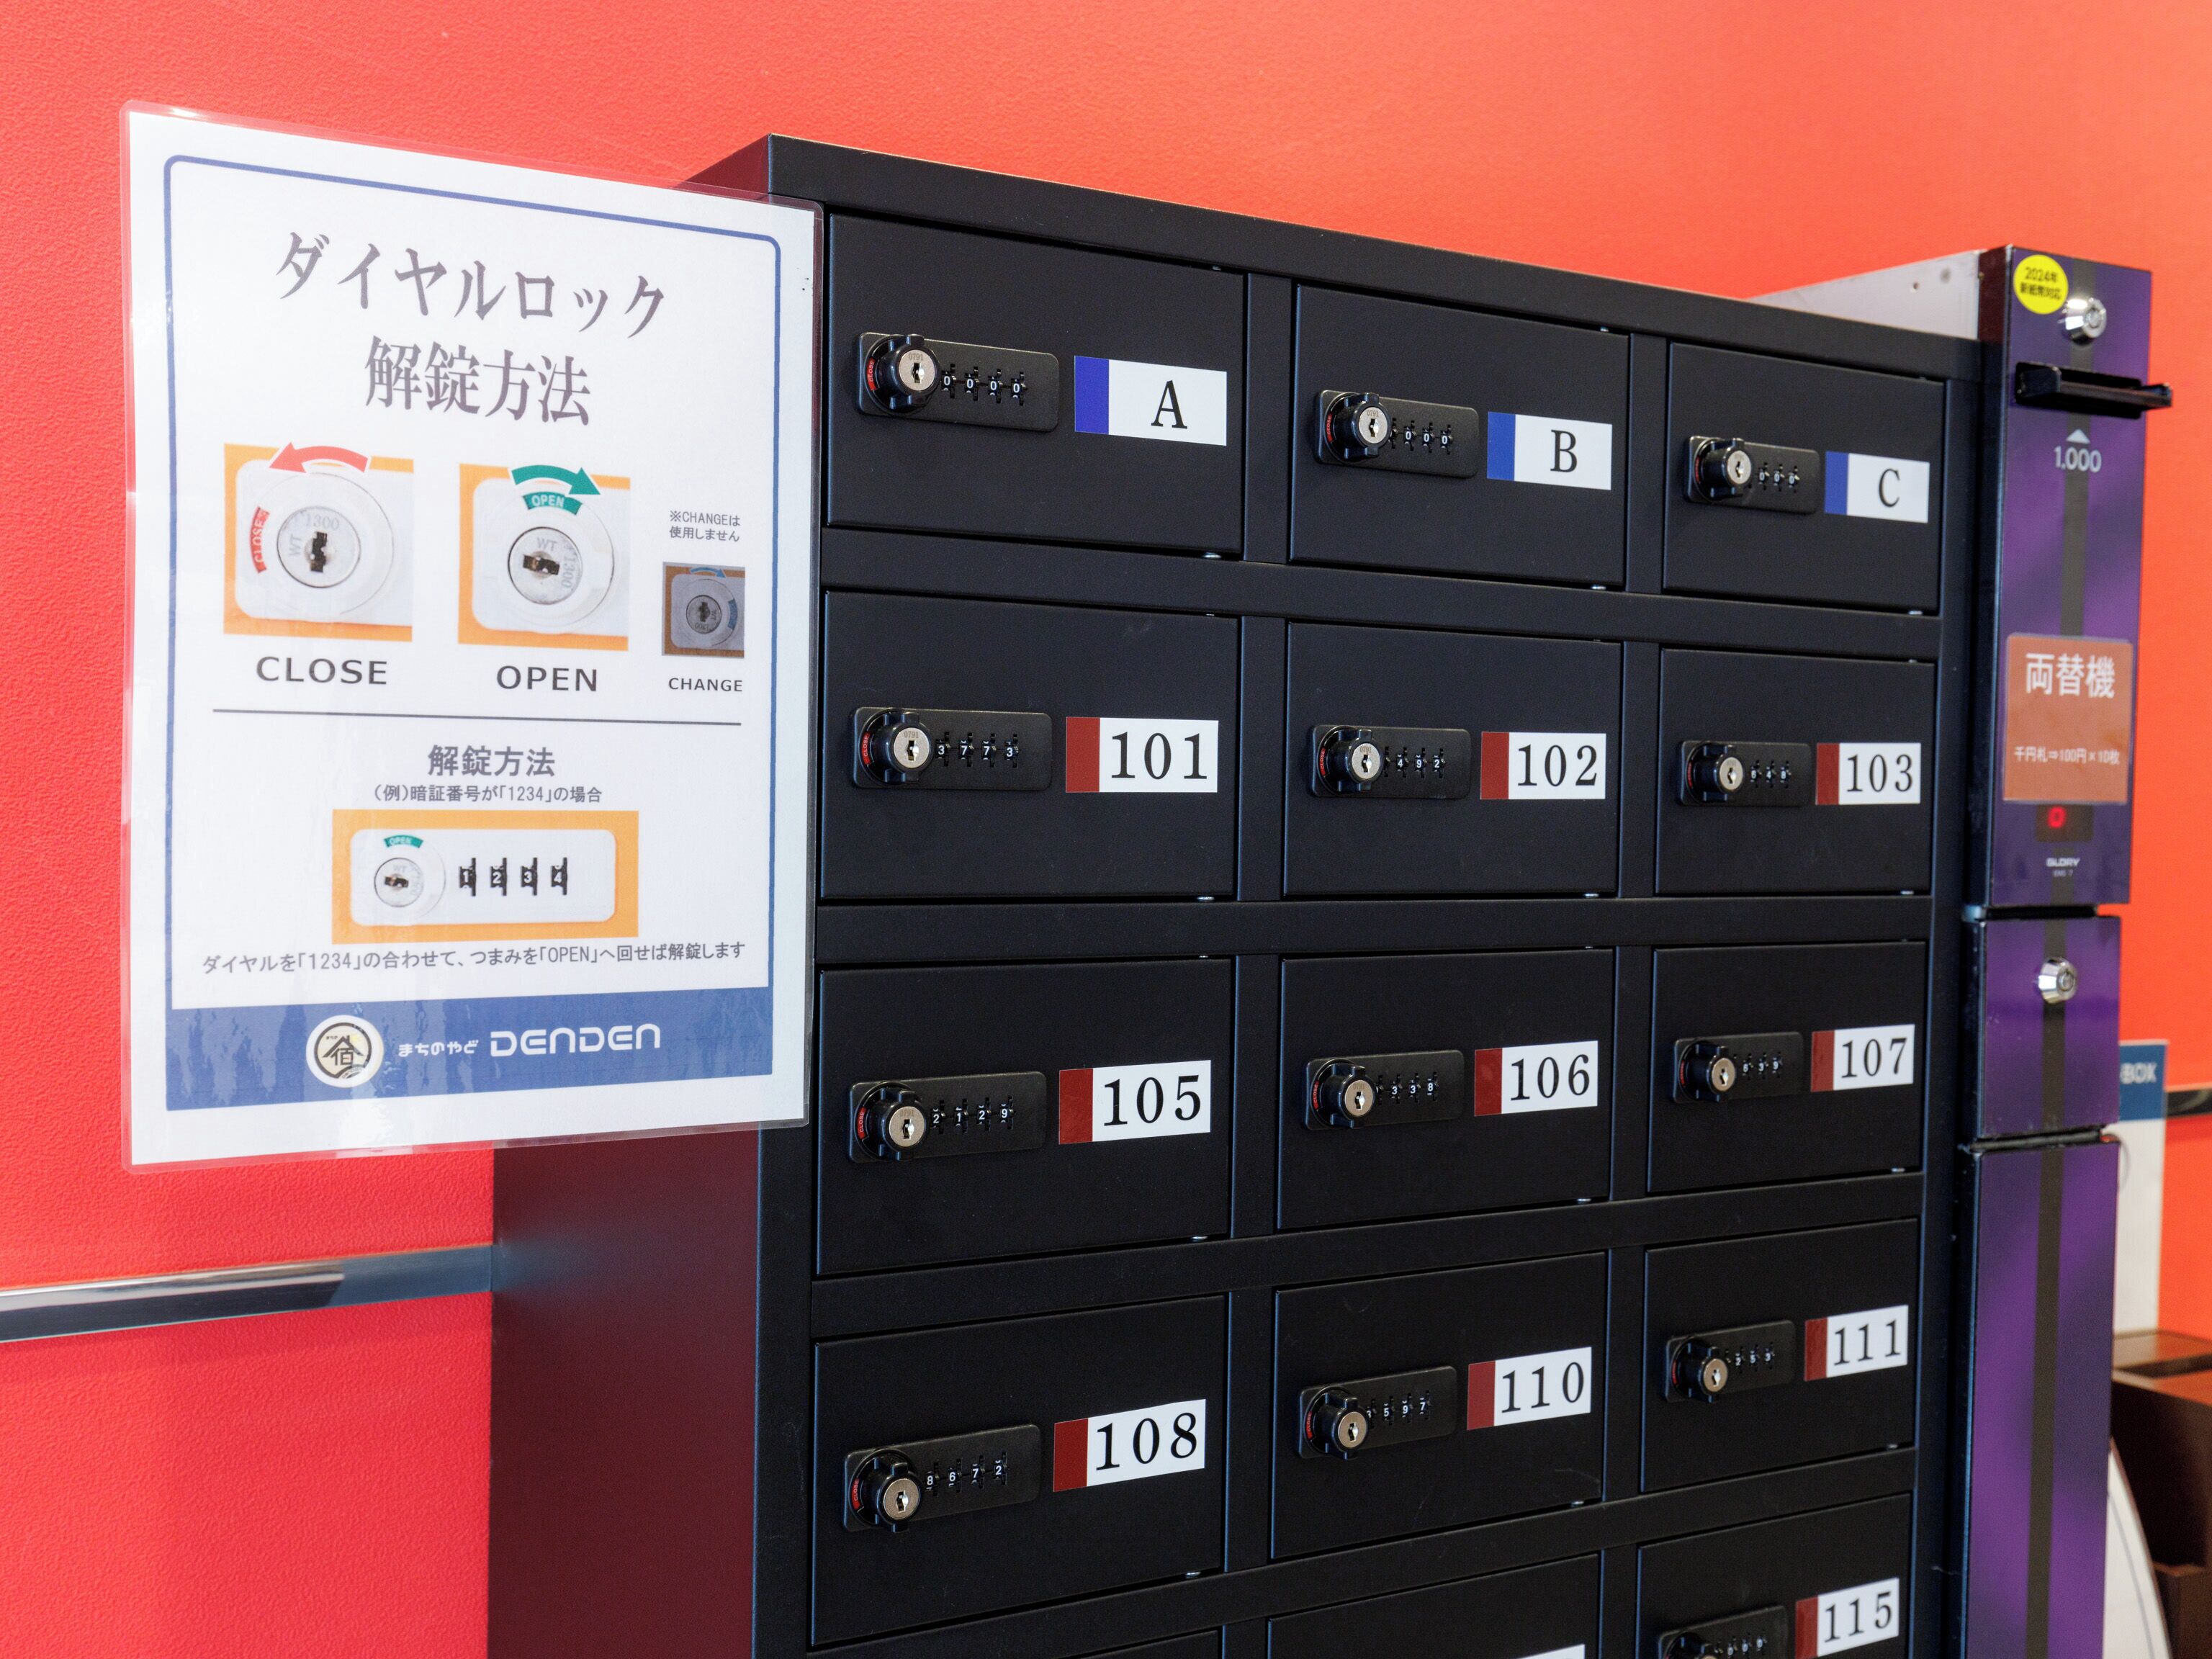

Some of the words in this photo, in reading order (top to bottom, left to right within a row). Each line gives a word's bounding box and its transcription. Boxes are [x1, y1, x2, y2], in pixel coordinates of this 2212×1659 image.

[275, 231, 665, 338] ダイヤルロック
[365, 335, 591, 426] 解錠方法
[1151, 379, 1188, 430] A
[1550, 428, 1578, 473] B
[531, 495, 565, 508] OPEN
[1878, 468, 1901, 508] C
[669, 525, 740, 542] 使用しません
[256, 656, 387, 685] CLOSE
[496, 665, 597, 692] OPEN
[668, 678, 743, 692] CHANGE
[2026, 652, 2116, 698] 両替機
[428, 744, 556, 778] 解錠方法
[1111, 731, 1208, 780] 101
[1517, 744, 1598, 787] 102
[1846, 754, 1913, 792] 103
[398, 1040, 479, 1058] まちのやど
[490, 1023, 661, 1057] DENDEN
[1840, 1038, 1907, 1078] 107
[1510, 1053, 1591, 1101] 106
[1103, 1074, 1202, 1126] 105
[1834, 1319, 1901, 1366] 111
[1501, 1362, 1585, 1413] 110
[1095, 1411, 1198, 1471] 108
[1824, 1591, 1892, 1643] 115
